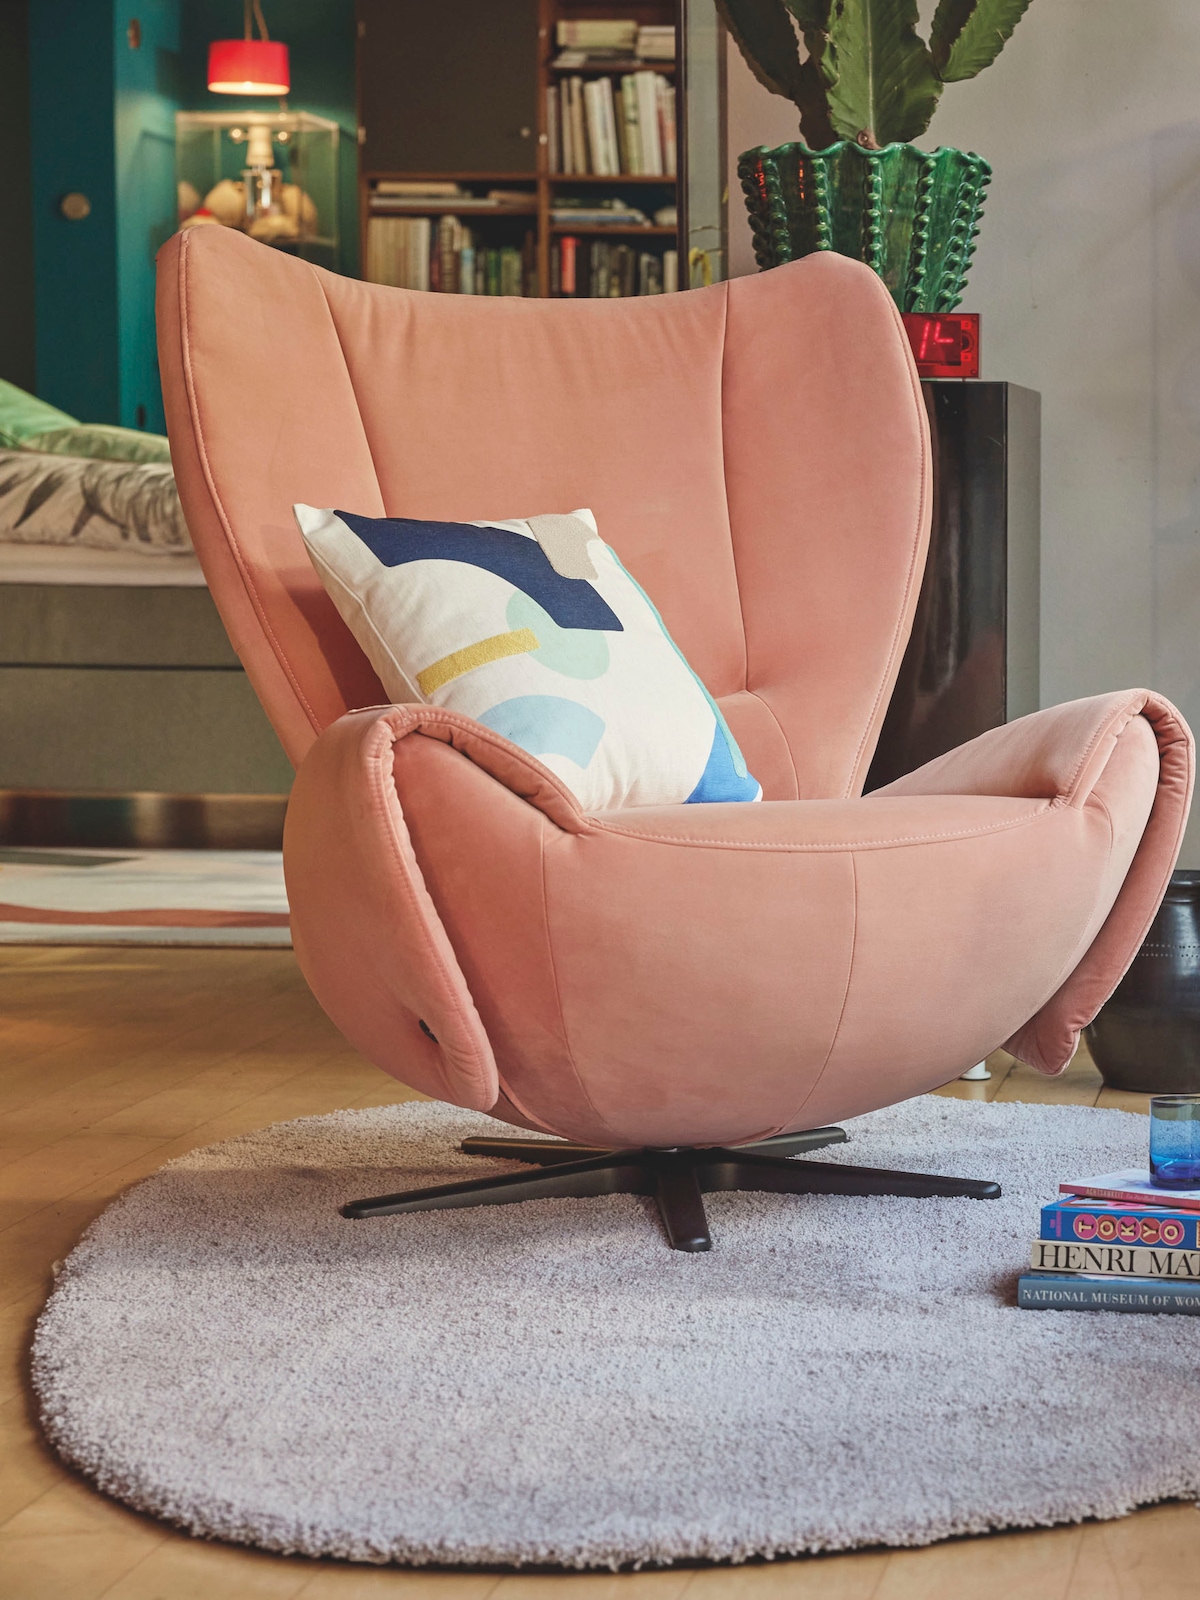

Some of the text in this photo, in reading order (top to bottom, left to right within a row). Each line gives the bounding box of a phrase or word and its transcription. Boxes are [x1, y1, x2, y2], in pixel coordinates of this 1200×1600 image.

[1078, 1219, 1180, 1241] TOKYO
[1038, 1244, 1136, 1272] HENRI
[1023, 1289, 1088, 1303] NATIONAL
[1091, 1292, 1149, 1305] MUSEUM
[1153, 1295, 1170, 1306] OF
